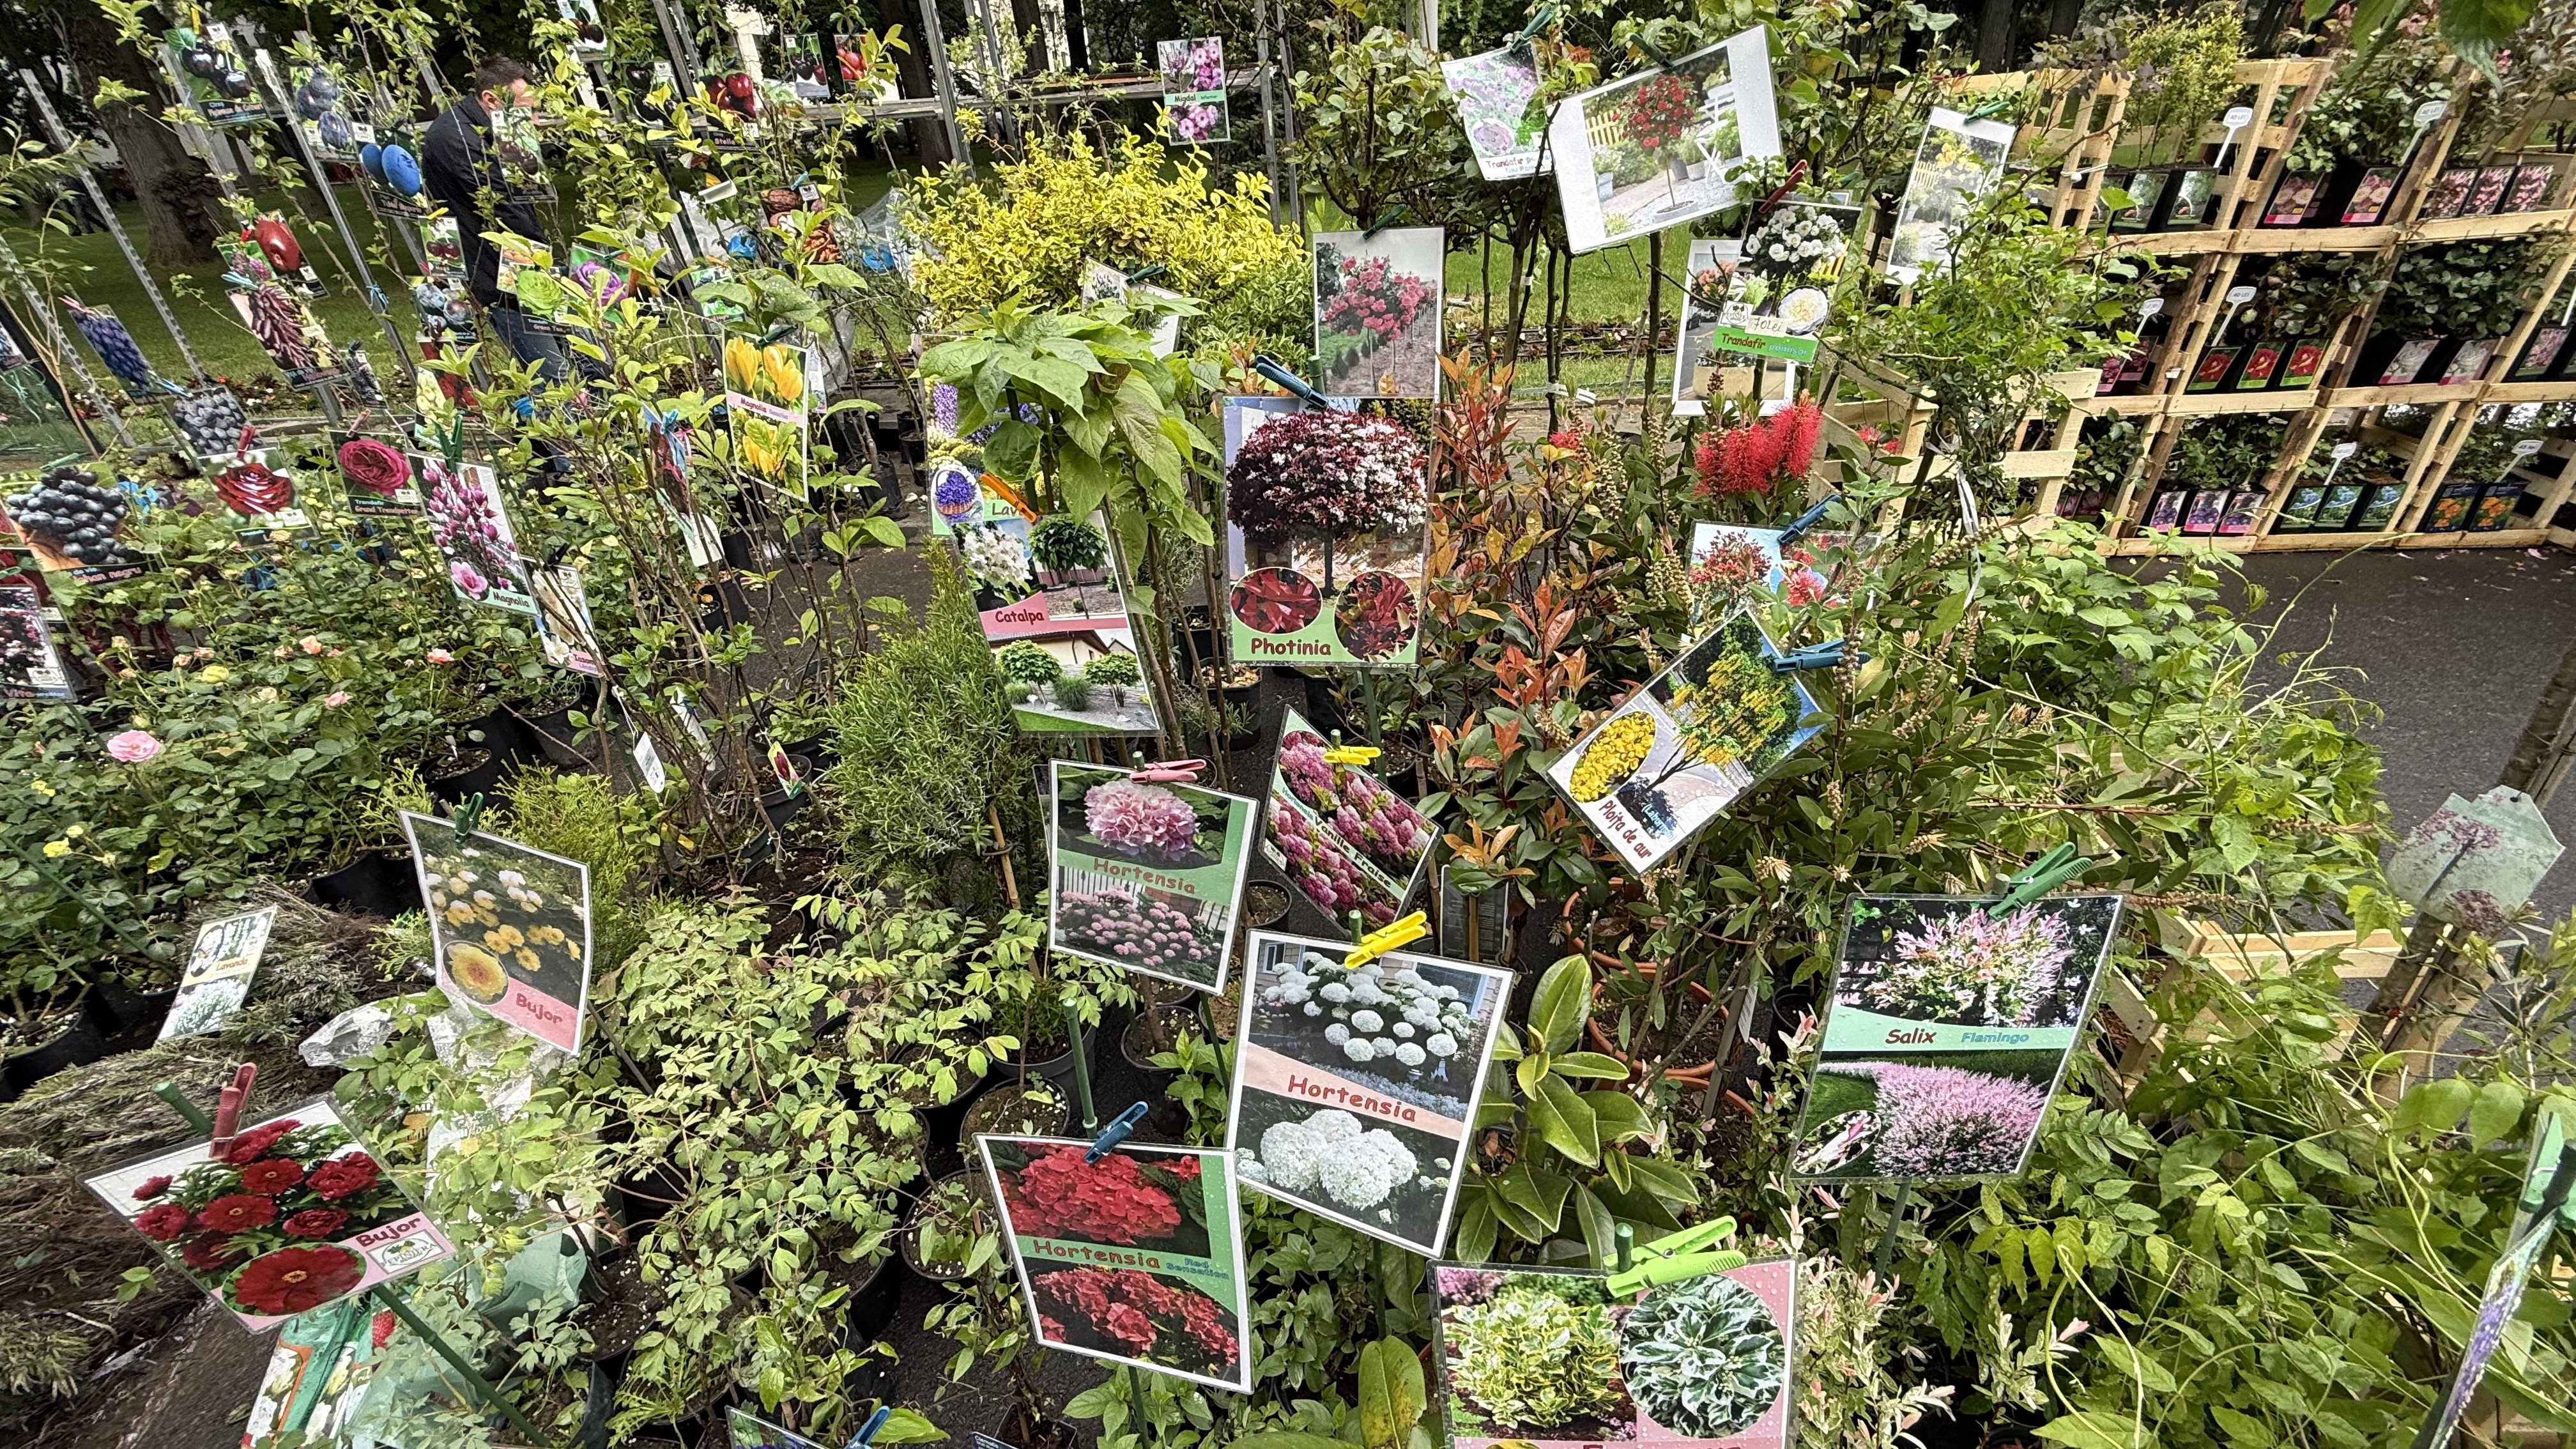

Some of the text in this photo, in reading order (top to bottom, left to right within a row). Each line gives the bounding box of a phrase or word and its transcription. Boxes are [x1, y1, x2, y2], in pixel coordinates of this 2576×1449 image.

[1174, 93, 1196, 103] Migdal
[1485, 157, 1524, 168] Trandafir
[1722, 333, 1766, 349] Trandafir
[740, 397, 767, 413] Magnolia
[109, 567, 142, 578] negru
[493, 592, 530, 607] Magnolia
[995, 609, 1045, 625] Catalpa
[1251, 638, 1331, 656] Photinia
[1315, 816, 1350, 853] Vanille
[1354, 853, 1391, 888] Fraise
[1623, 829, 1637, 844] de
[1633, 843, 1652, 859] aur
[1094, 858, 1195, 894] Hortensia
[215, 957, 248, 971] Lavanda
[516, 993, 562, 1023] Bujor
[1885, 1027, 2029, 1044] Salix Flamingo
[1288, 1075, 1416, 1122] Hortensia
[356, 1218, 420, 1247] Bujor
[1032, 1239, 1160, 1268] Hortensia
[1166, 1262, 1229, 1279] Sensation
[1184, 1258, 1209, 1268] Red
